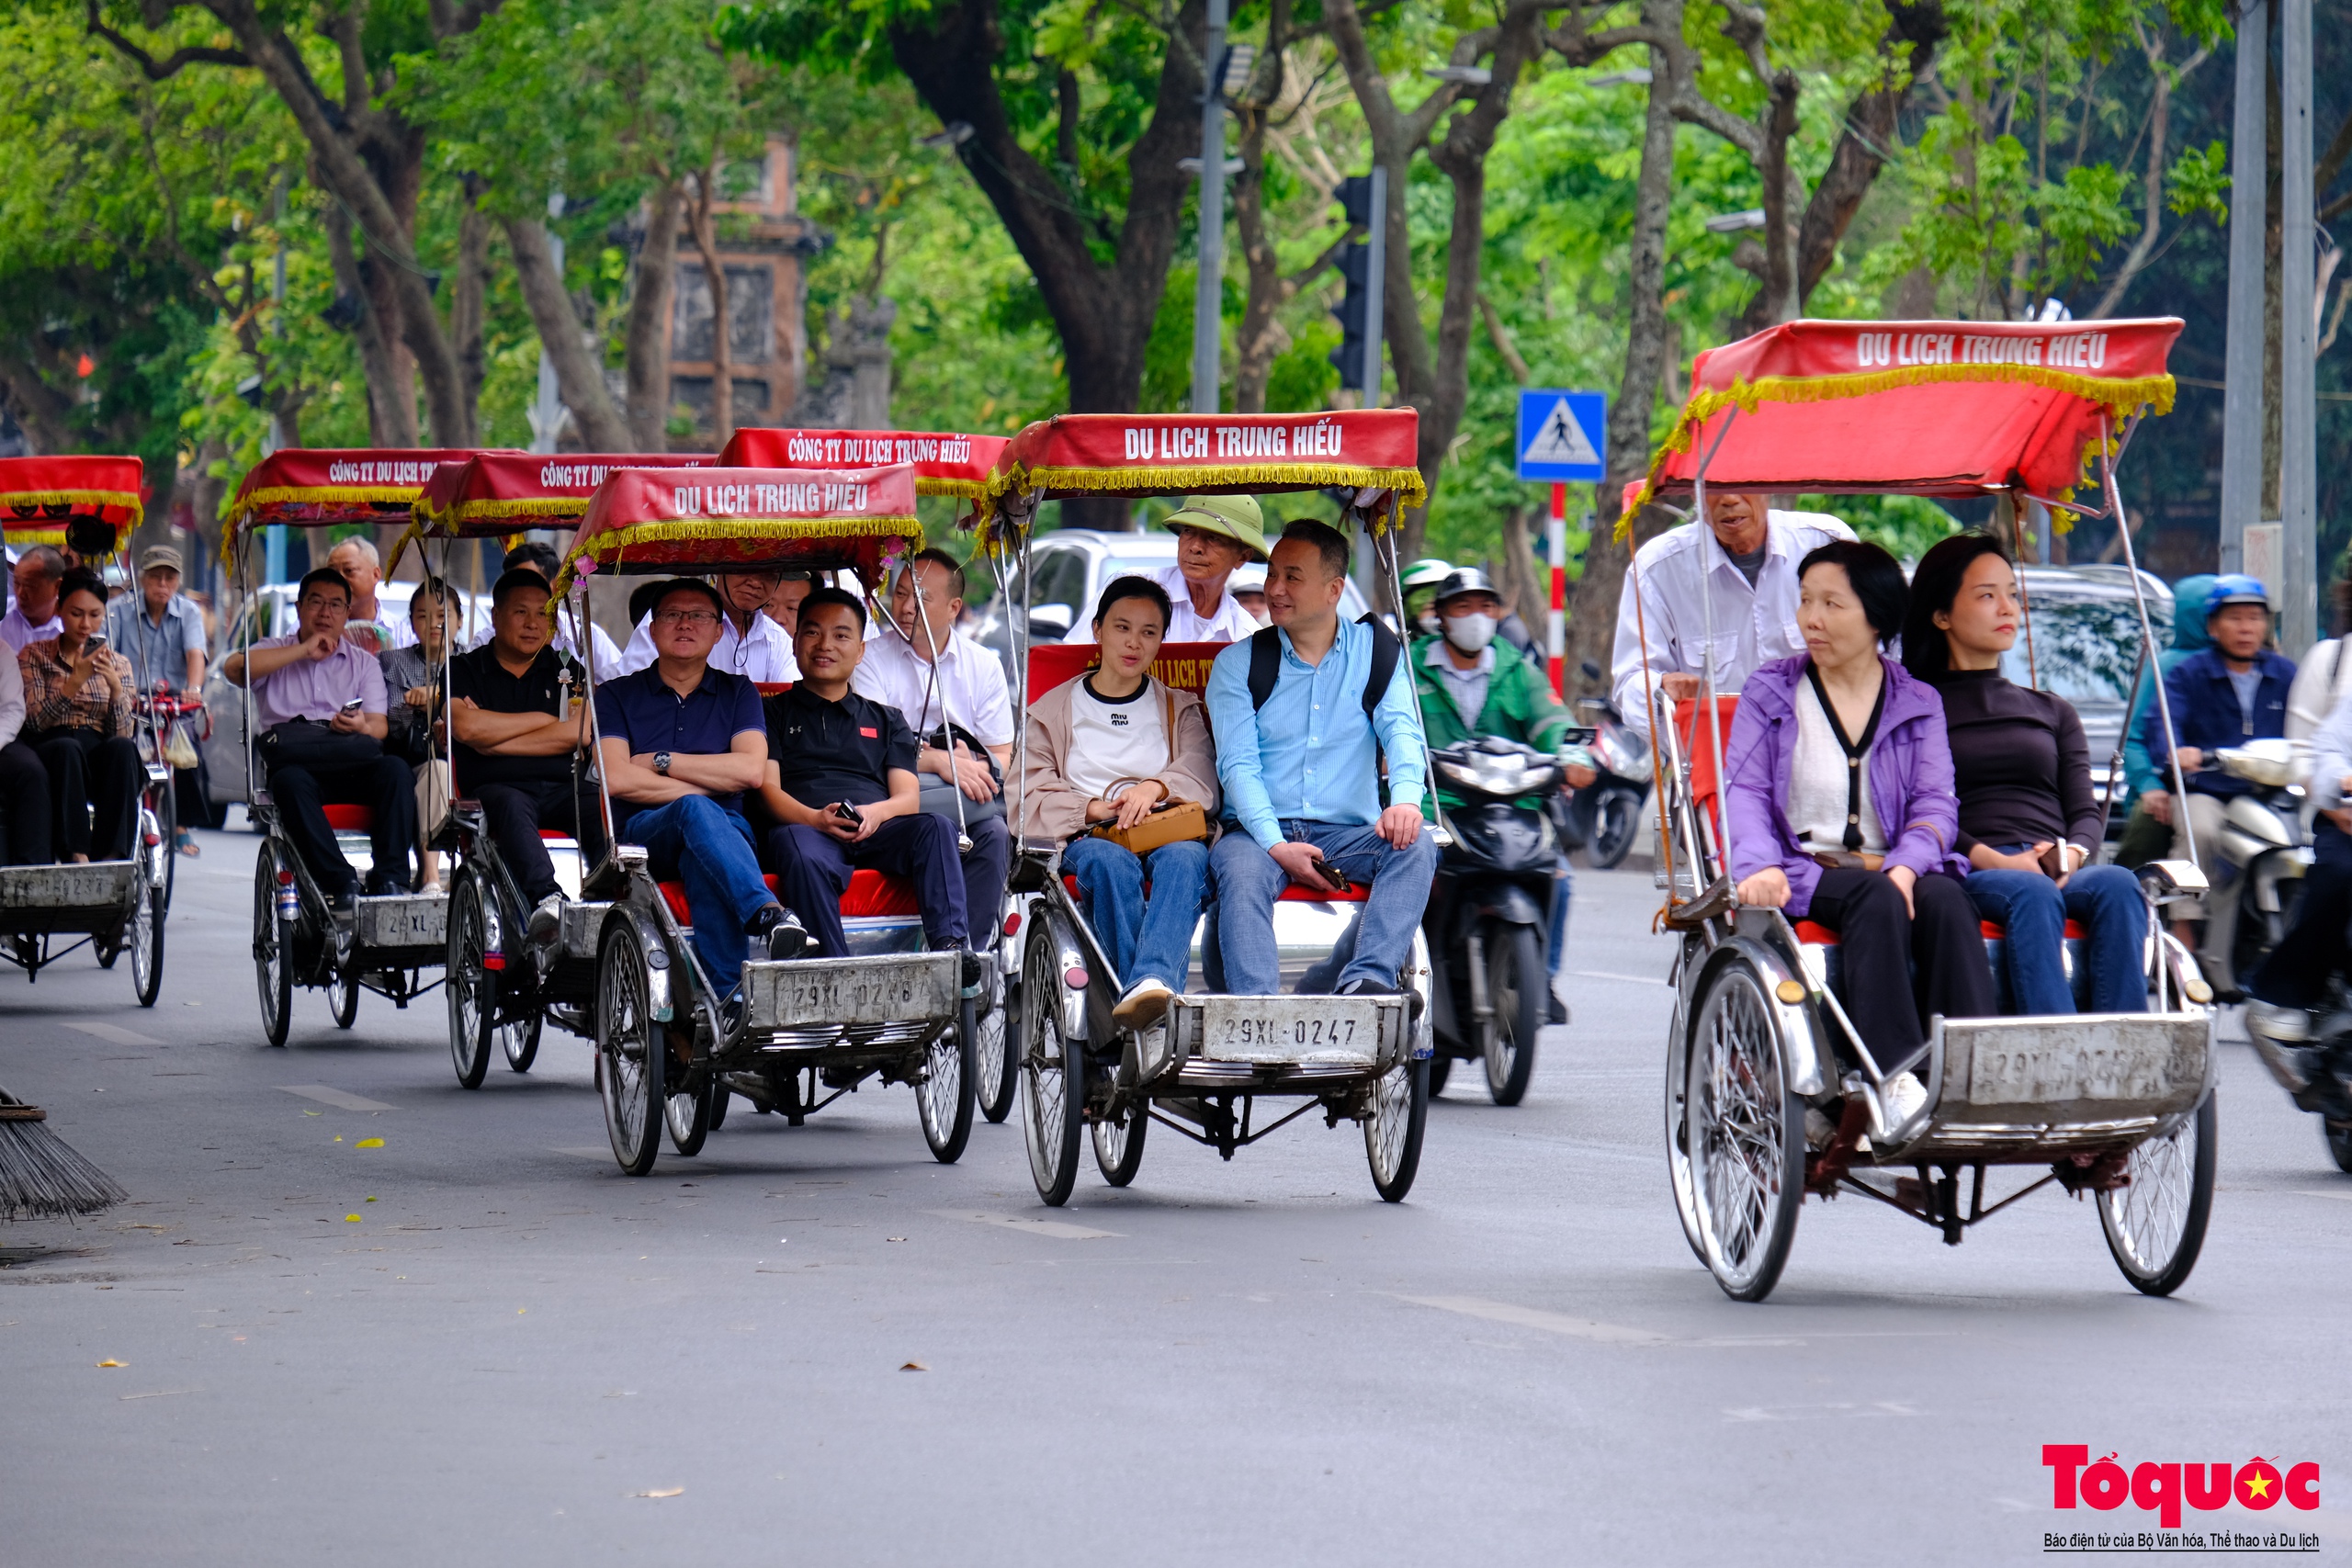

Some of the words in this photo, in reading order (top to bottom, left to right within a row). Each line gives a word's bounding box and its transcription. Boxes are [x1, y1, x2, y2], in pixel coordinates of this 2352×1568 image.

[1858, 333, 1892, 367] DU
[1898, 333, 1955, 365] LICH
[1962, 334, 2043, 366] TRUNG
[788, 431, 823, 462] CÔNG
[826, 439, 842, 462] TY
[844, 439, 863, 463] DU
[865, 439, 893, 468] LỊCH
[896, 439, 938, 463] TRUNG
[939, 434, 971, 464] HIẾU
[1125, 428, 1153, 459] DU
[1161, 427, 1209, 458] LICH
[1216, 426, 1286, 457] TRUNG
[1293, 417, 1342, 457] HIẾU
[329, 458, 359, 482] CÔNG
[360, 462, 374, 482] TY
[377, 462, 392, 482] DU
[393, 462, 418, 485] LỊCH
[540, 460, 572, 488] CÔNG
[574, 466, 589, 487] TY
[674, 487, 701, 514] DU
[707, 484, 750, 514] LICH
[755, 483, 820, 513] TRUNG
[824, 475, 868, 512] HIẾU
[1224, 1018, 1357, 1045] 29XL-0247
